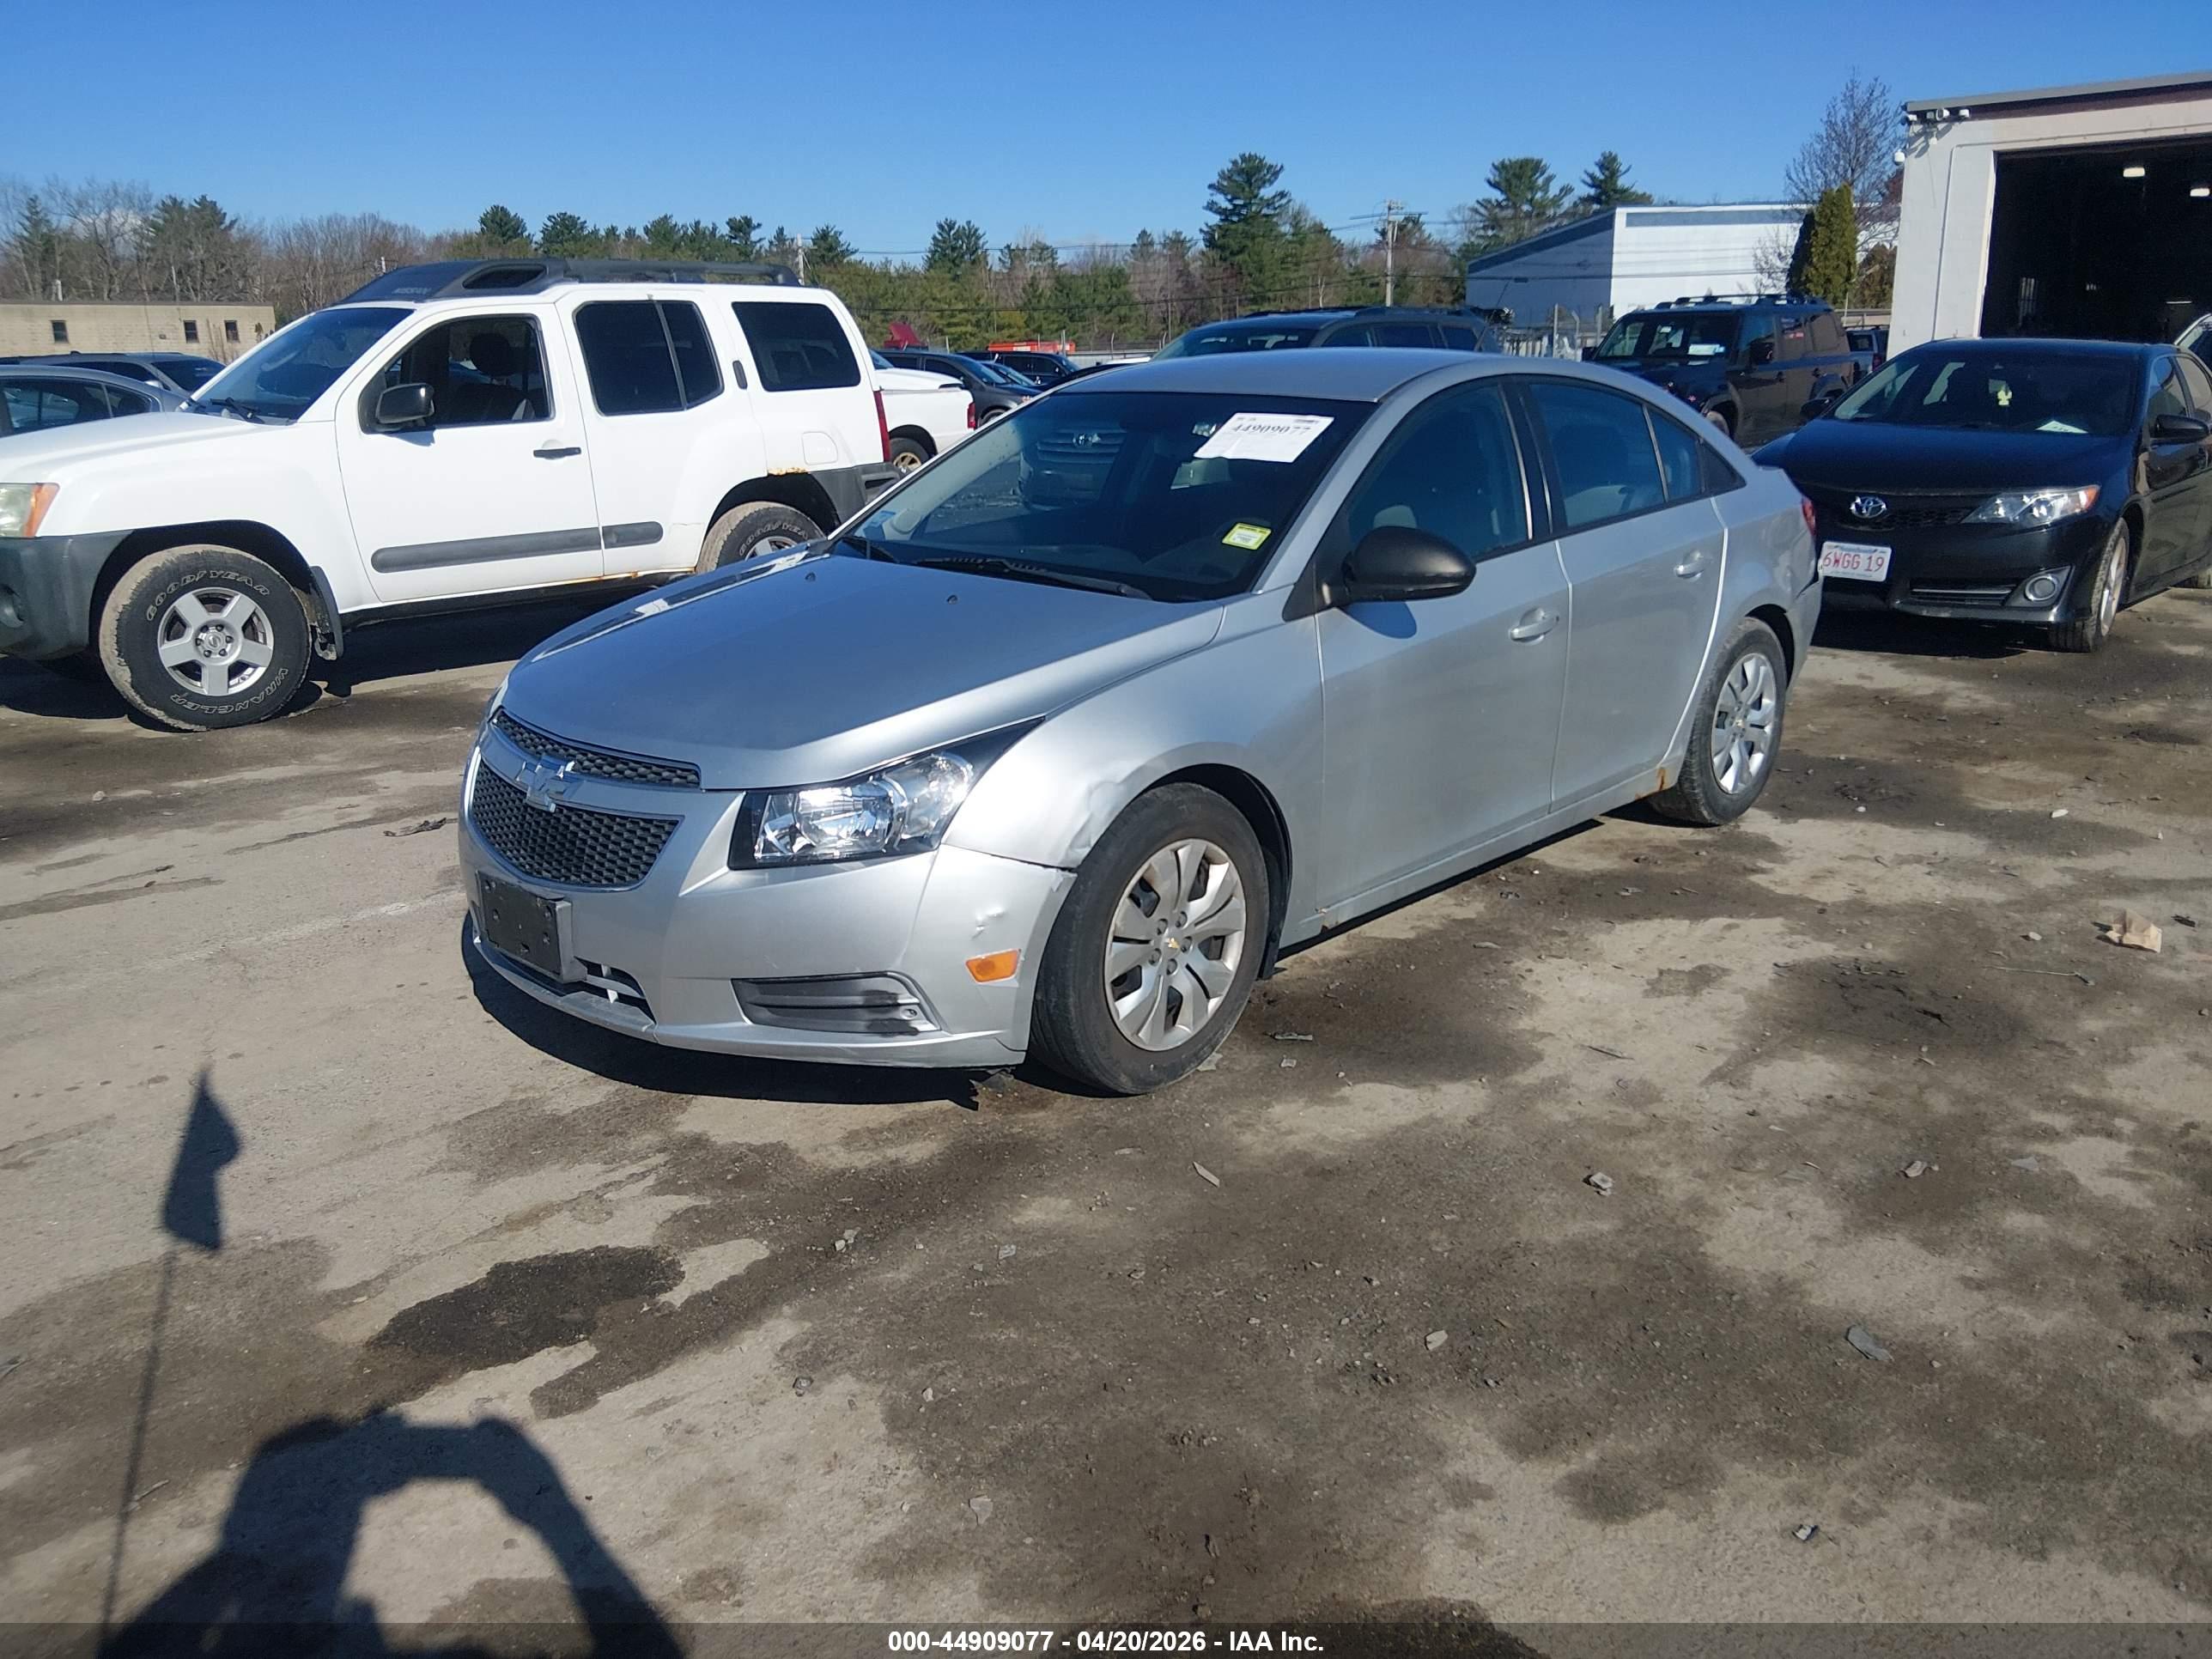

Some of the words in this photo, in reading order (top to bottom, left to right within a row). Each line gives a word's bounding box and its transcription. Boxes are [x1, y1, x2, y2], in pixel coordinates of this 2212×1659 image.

[739, 521, 808, 556] GOODYEA
[1824, 551, 1861, 570] 6WGG
[1864, 555, 1885, 573] 19
[147, 570, 270, 621] GOODYEAR
[170, 668, 289, 714] WRANGLER
